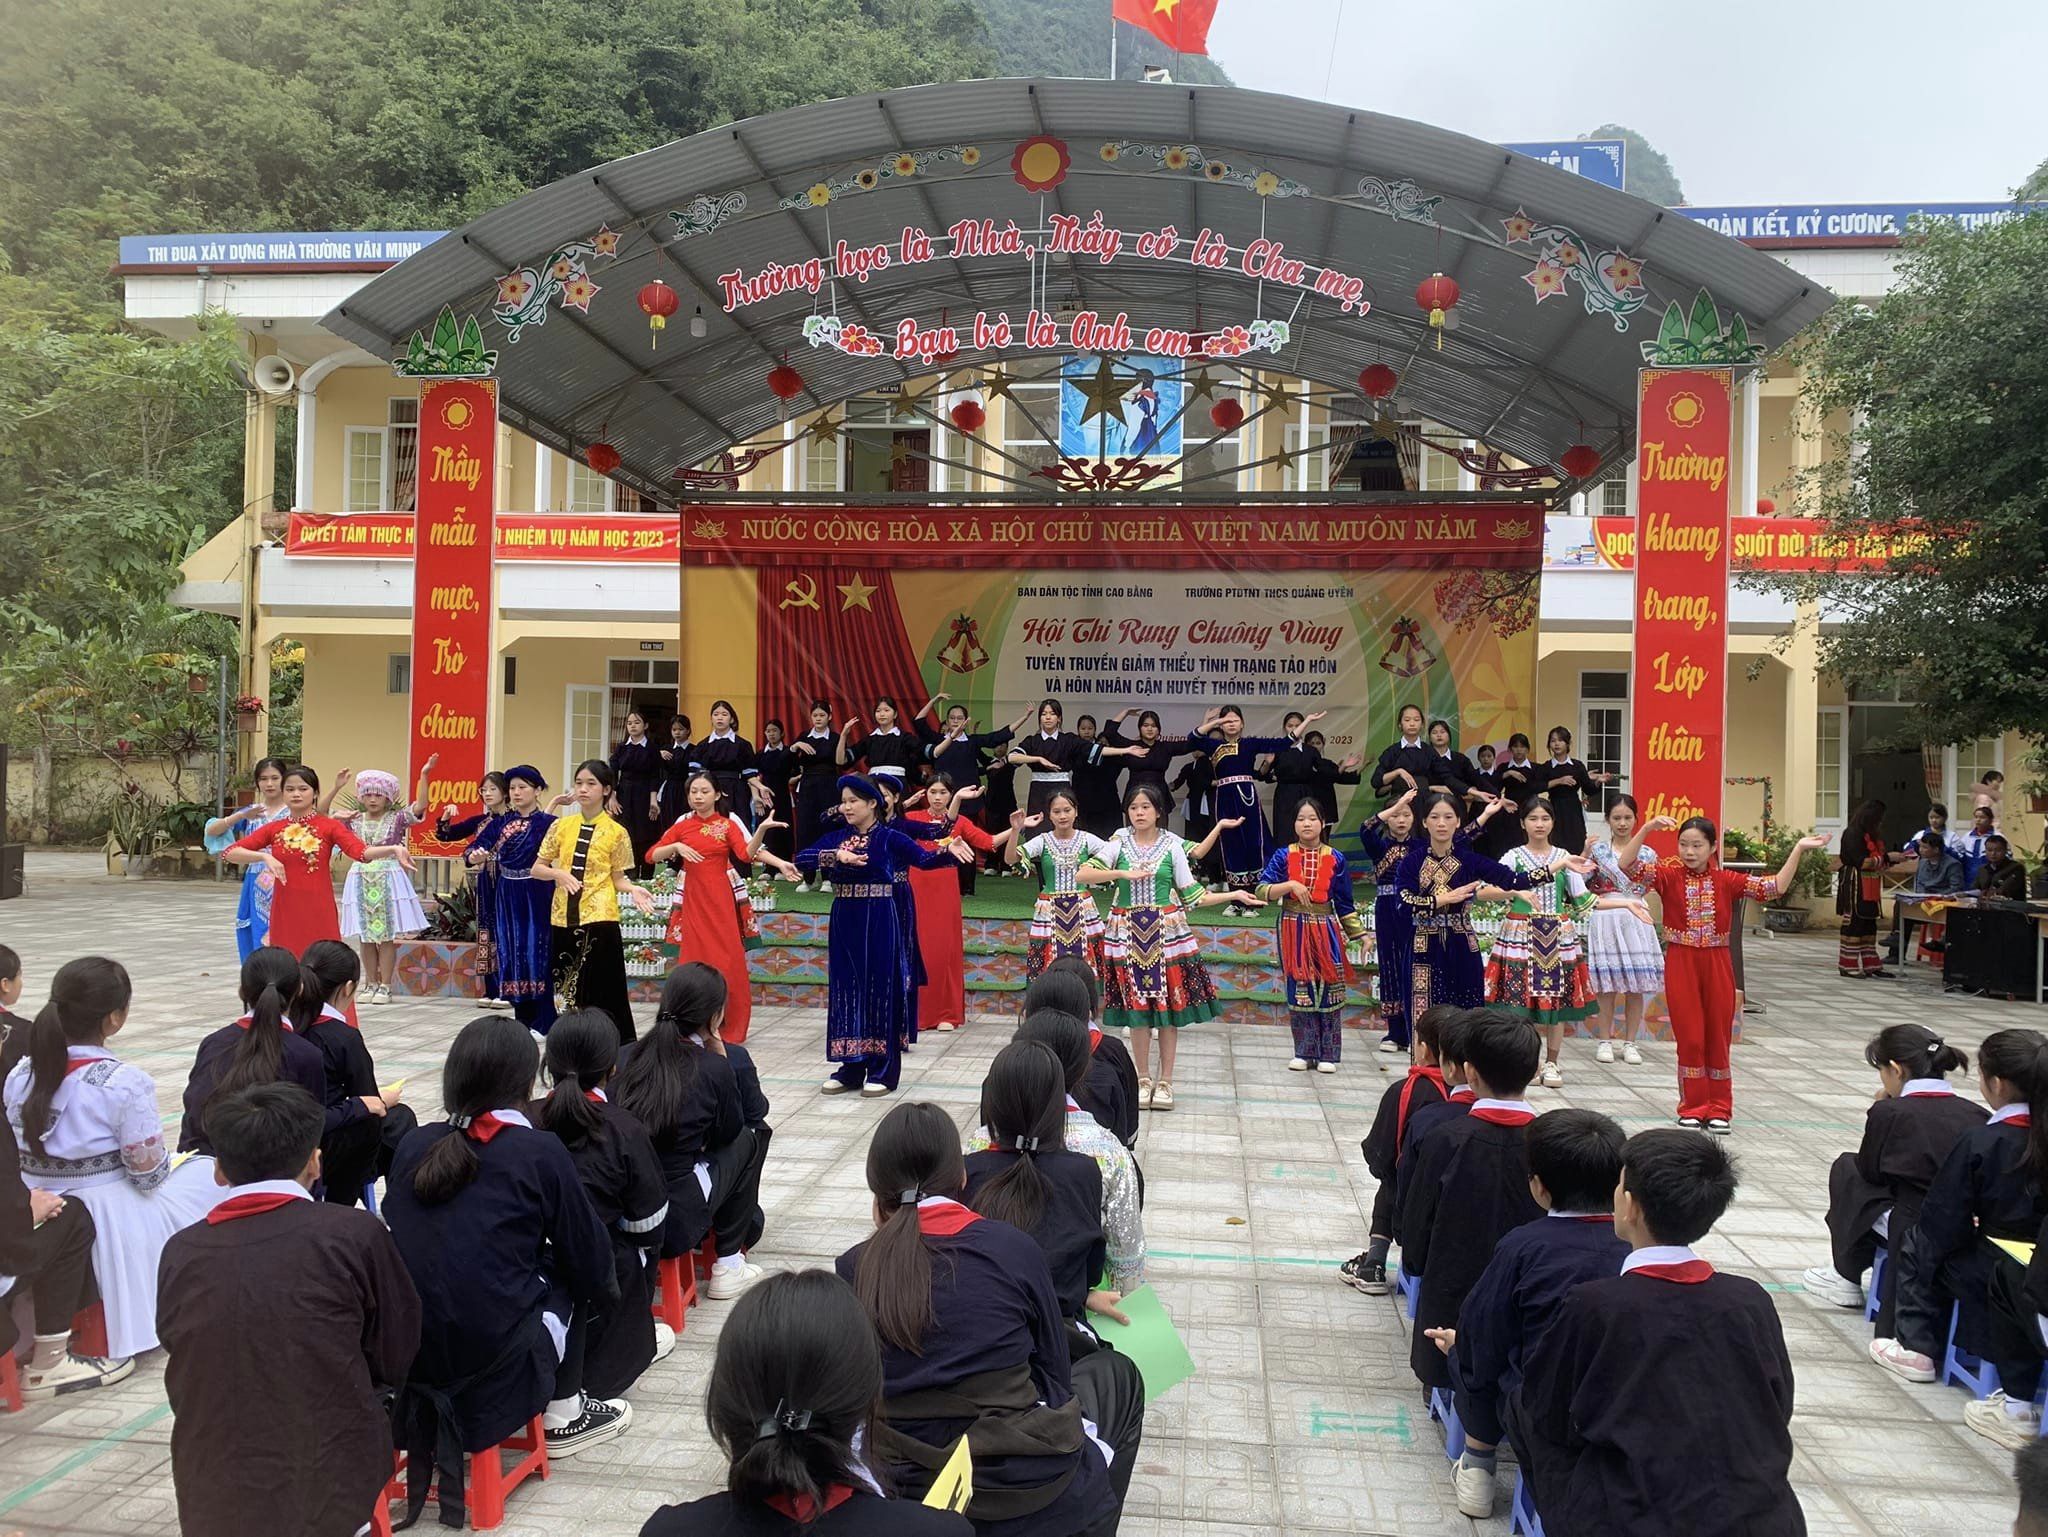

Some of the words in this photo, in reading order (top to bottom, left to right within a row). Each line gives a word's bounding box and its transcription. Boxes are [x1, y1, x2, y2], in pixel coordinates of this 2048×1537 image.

[1693, 213, 1746, 237] OÀN
[1753, 209, 1790, 238] KẾT,
[1797, 209, 1822, 235] KỶ
[149, 247, 167, 262] THI
[171, 246, 197, 262] ĐUA
[201, 243, 225, 261] XÂY
[229, 242, 265, 263] DỰNG
[269, 241, 296, 260] NHÀ
[298, 239, 351, 260] TRƯỜNG
[354, 241, 381, 259] VĂN
[718, 257, 825, 312] Trường
[836, 240, 890, 282] học
[900, 227, 934, 264] là
[949, 219, 1034, 261] Nhà,
[1045, 210, 1122, 264] Thầy
[1137, 225, 1178, 259] cô
[1191, 228, 1229, 269] là
[1242, 239, 1304, 286] Cha
[1314, 268, 1372, 316] mẹ,
[893, 318, 959, 366] Bạn
[973, 311, 1012, 350] bè
[1026, 310, 1060, 350] là
[1071, 311, 1133, 352] Anh
[1145, 328, 1191, 358] em
[430, 444, 481, 491] Thầy
[1641, 440, 1727, 491] Trường
[300, 521, 338, 543] QUYẾT
[341, 523, 367, 543] TÂM
[371, 525, 402, 547] THỰC
[430, 506, 478, 546] mẫu
[505, 525, 546, 549] NHIỆM
[550, 529, 566, 550] VỤ
[569, 526, 600, 546] NĂM
[603, 530, 629, 551] HỌC
[632, 531, 664, 548] 2023
[741, 514, 807, 540] NƯỚC
[813, 514, 881, 547] CỘNG
[887, 515, 940, 542] HÒA
[947, 516, 981, 542] XÃ
[989, 514, 1036, 547] HỘI
[1043, 512, 1093, 543] CHỦ
[1100, 517, 1184, 542] NGHĨA
[1191, 515, 1252, 548] VIỆT
[1259, 520, 1320, 542] NAM
[1326, 513, 1407, 541] MUÔN
[1413, 512, 1477, 540] NĂM
[1645, 512, 1721, 562] khang
[1734, 526, 1774, 557] SUỐT
[1778, 529, 1804, 557] ĐỜI
[430, 584, 480, 620] mực,
[1017, 587, 1037, 597] BAN
[1039, 585, 1059, 597] DÂN
[1061, 585, 1079, 599] TỘC
[1082, 584, 1103, 597] TỈNH
[1105, 587, 1124, 598] CAO
[1185, 585, 1223, 598] TRƯỜNG
[1225, 588, 1261, 598] PTDTNT
[1264, 588, 1289, 598] THCS
[1291, 585, 1325, 599] QUẢNG
[1643, 587, 1718, 631] trang,
[1022, 618, 1067, 647] Hội
[1072, 617, 1113, 644] Thi
[1118, 618, 1180, 651] Rung
[1187, 619, 1273, 651] Chuông
[1279, 619, 1344, 652] Vàng
[432, 636, 468, 675] Trò
[1025, 654, 1065, 671] TUYÊN
[1069, 652, 1118, 671] TRUYỀN
[1122, 653, 1155, 672] GIẢM
[1159, 651, 1195, 672] THIỂU
[1199, 656, 1229, 673] TÌNH
[1233, 658, 1276, 676] TRẠNG
[1280, 654, 1305, 674] TẢO
[1309, 656, 1337, 674] HÔN
[1045, 676, 1062, 693] VÀ
[1065, 675, 1092, 693] HÔN
[1095, 676, 1132, 694] NHÂN
[1135, 676, 1162, 696] CẬN
[1166, 676, 1207, 695] HUYẾT
[1212, 676, 1255, 695] THỐNG
[1259, 679, 1290, 696] NĂM
[1294, 681, 1326, 696] 2023
[1652, 651, 1709, 700] Lớp
[420, 702, 478, 739] chăm
[1330, 735, 1353, 745] 2023
[1648, 722, 1706, 761] thân
